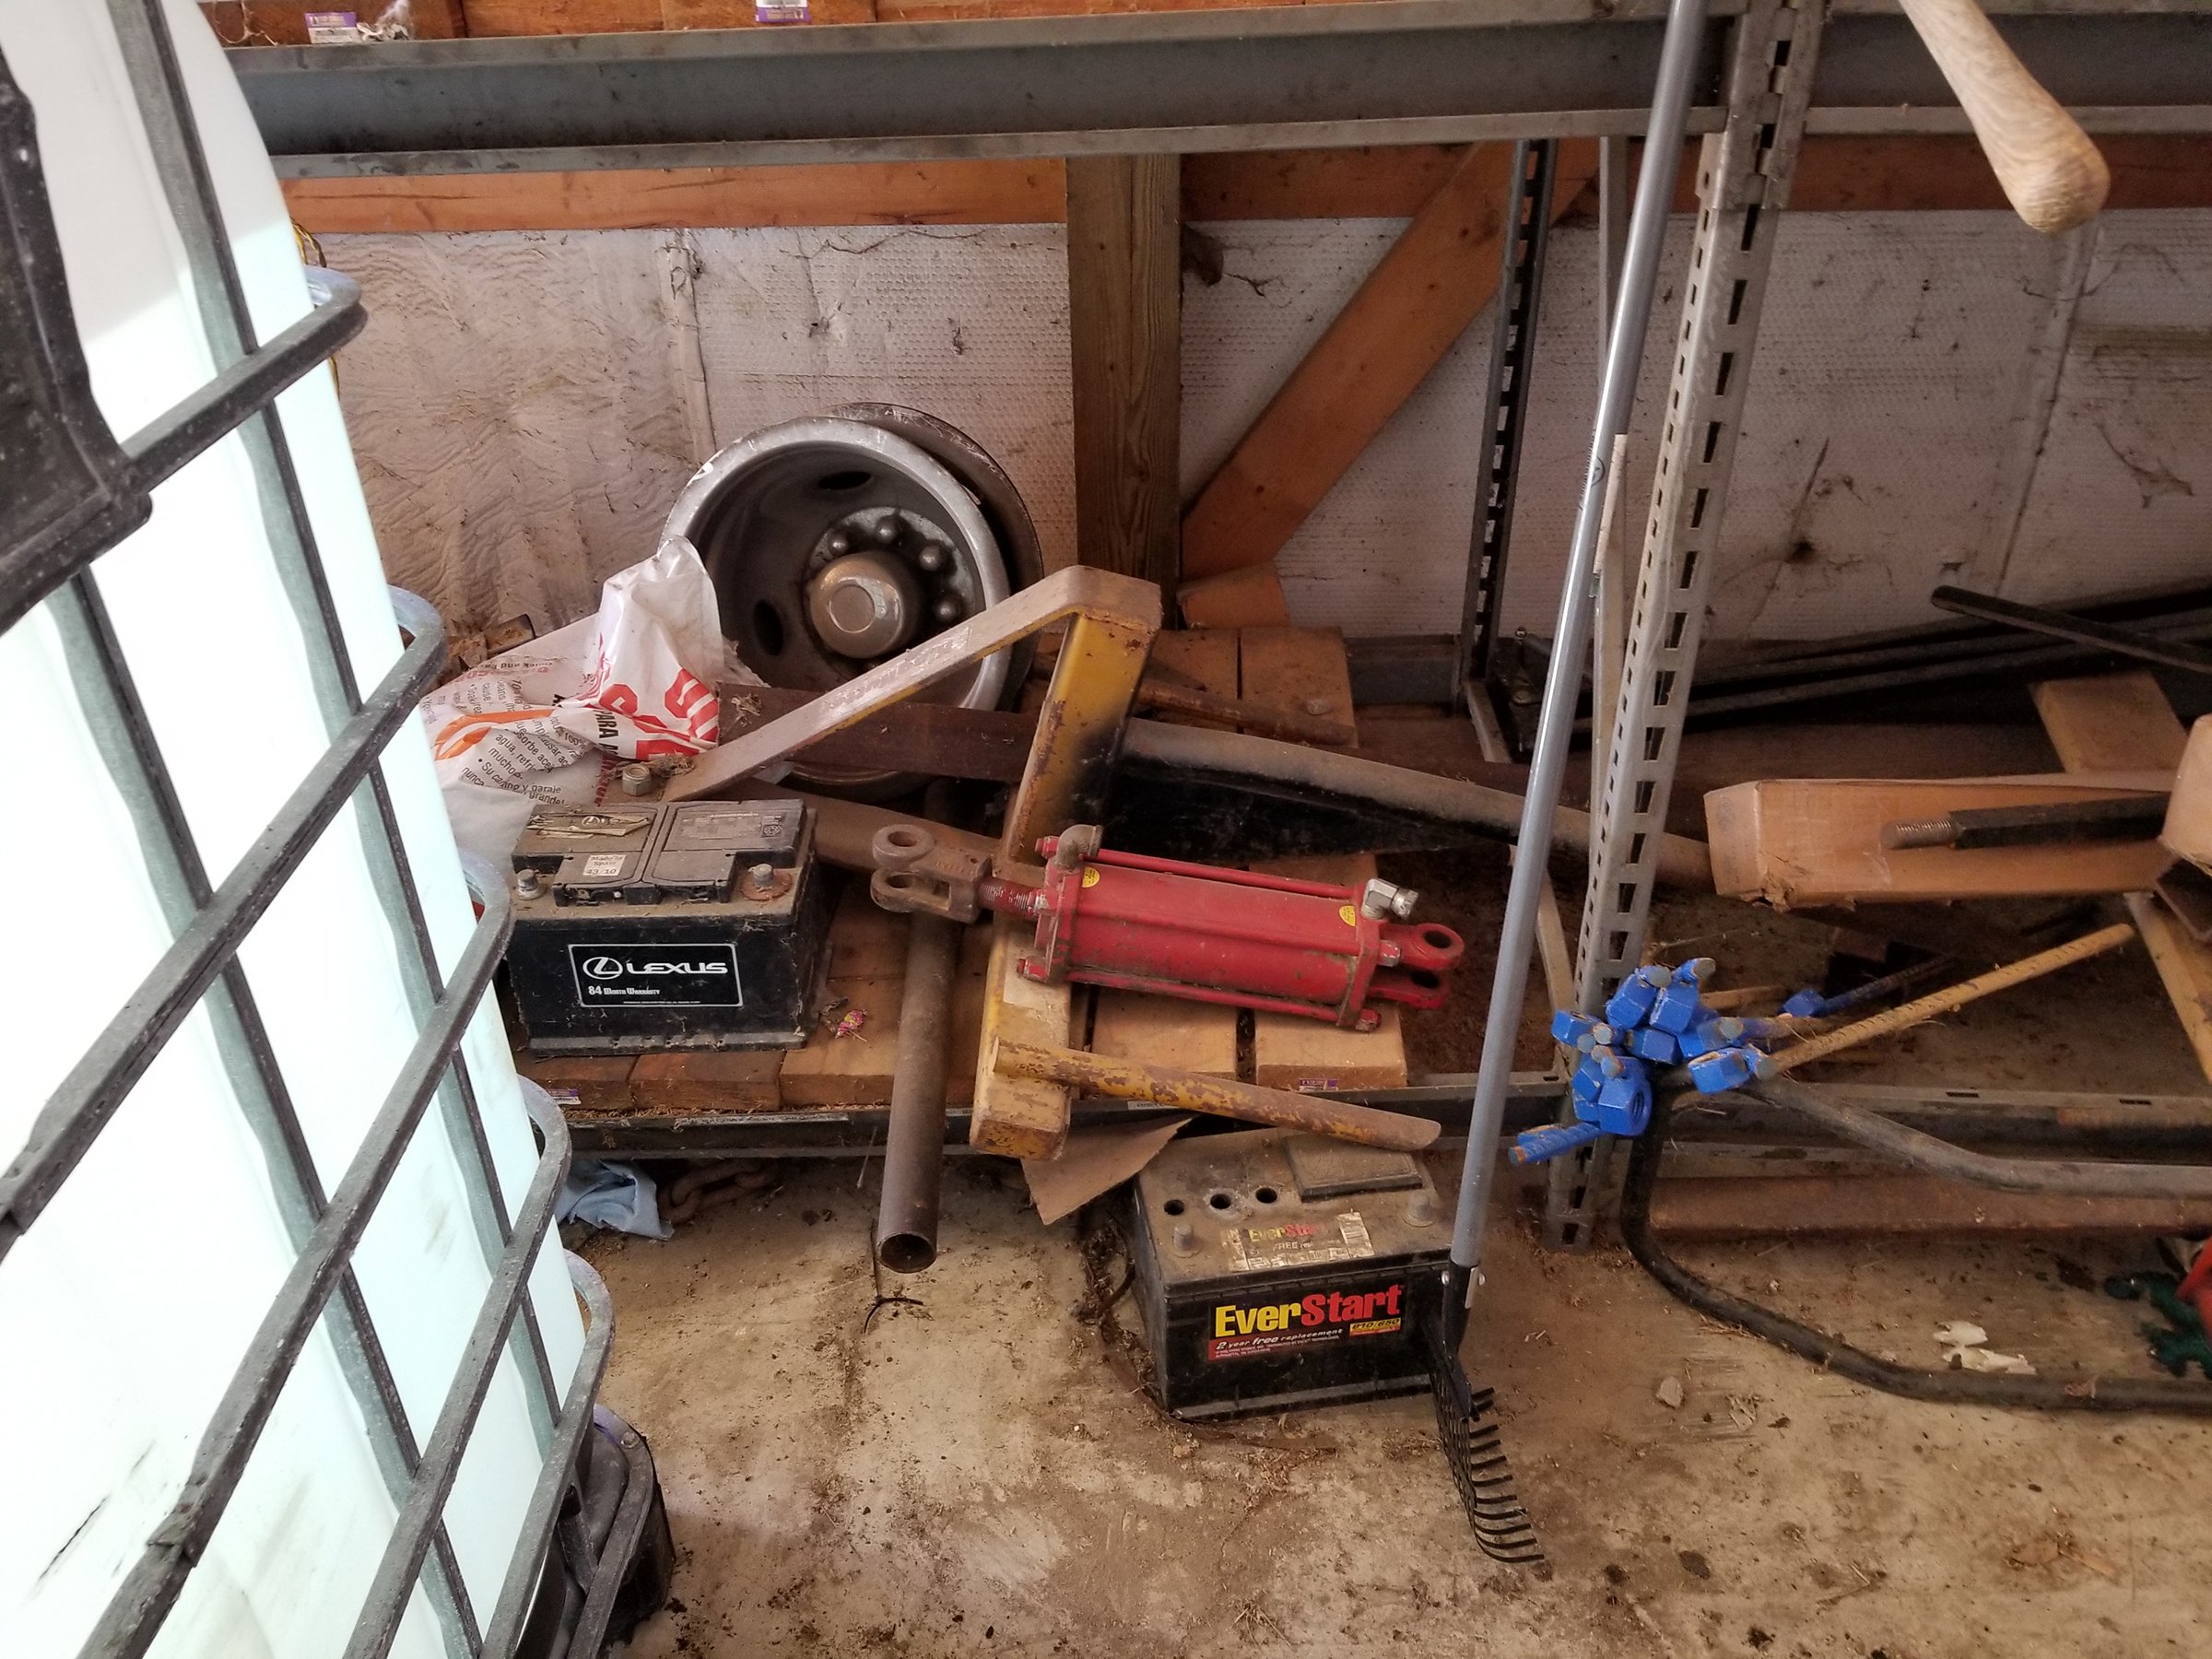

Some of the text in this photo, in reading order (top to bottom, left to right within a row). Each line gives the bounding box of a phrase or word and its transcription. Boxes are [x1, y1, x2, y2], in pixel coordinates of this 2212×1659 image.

[495, 733, 517, 756] agua,
[481, 761, 494, 776] Su
[626, 961, 729, 975] LEXUS
[587, 985, 603, 995] 84
[1215, 1283, 1403, 1338] EverStart
[1215, 1341, 1228, 1350] 2
[1228, 1340, 1251, 1349] year
[1252, 1336, 1279, 1346] free
[1280, 1328, 1344, 1342] replacement
